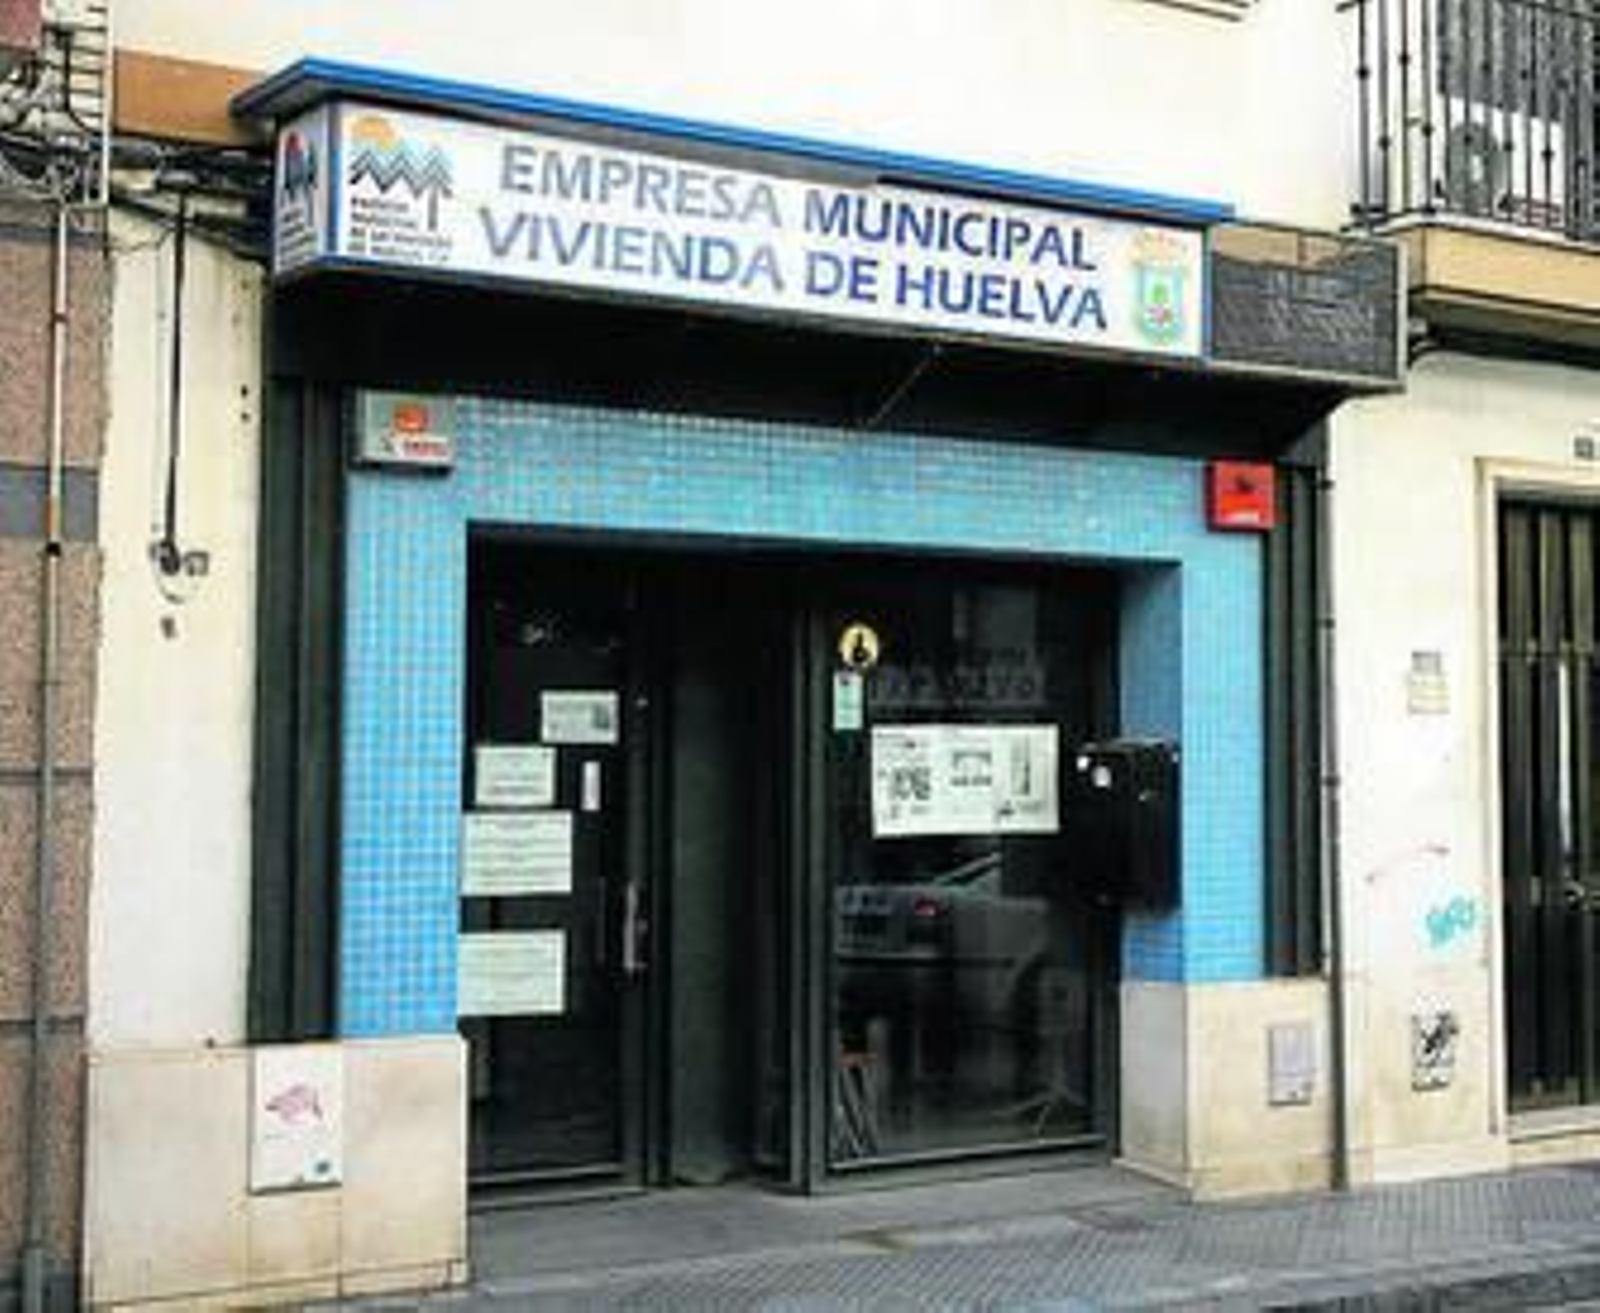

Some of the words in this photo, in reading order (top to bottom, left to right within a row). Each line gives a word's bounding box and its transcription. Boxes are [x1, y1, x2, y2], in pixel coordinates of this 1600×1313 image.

[478, 206, 784, 292] VIVIENDA
[805, 251, 879, 301] DE
[895, 264, 1106, 331] HUELVA
[500, 144, 781, 228] EMPRESA
[805, 191, 1096, 271] MUNICIPAL
